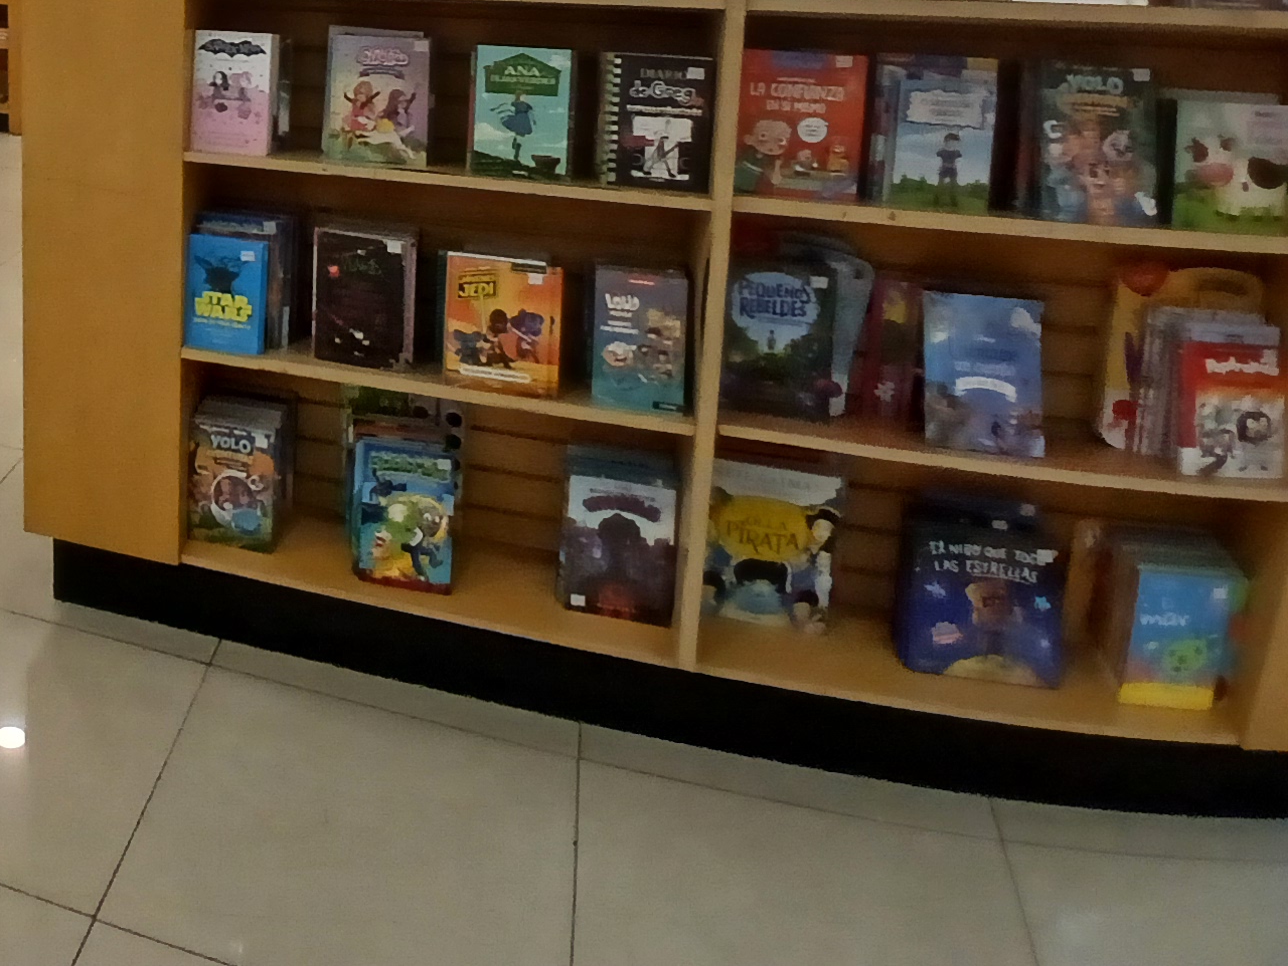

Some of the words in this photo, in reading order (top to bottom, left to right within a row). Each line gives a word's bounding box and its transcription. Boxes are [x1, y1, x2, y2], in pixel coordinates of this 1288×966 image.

[504, 65, 540, 77] ANA
[201, 291, 249, 307] STAR
[458, 281, 494, 297] JEDI
[195, 297, 253, 322] WARS
[211, 434, 252, 454] YOLO
[726, 519, 800, 554] PIRATA
[934, 560, 959, 573] LAS
[966, 559, 1038, 583] ESTRELLAS
